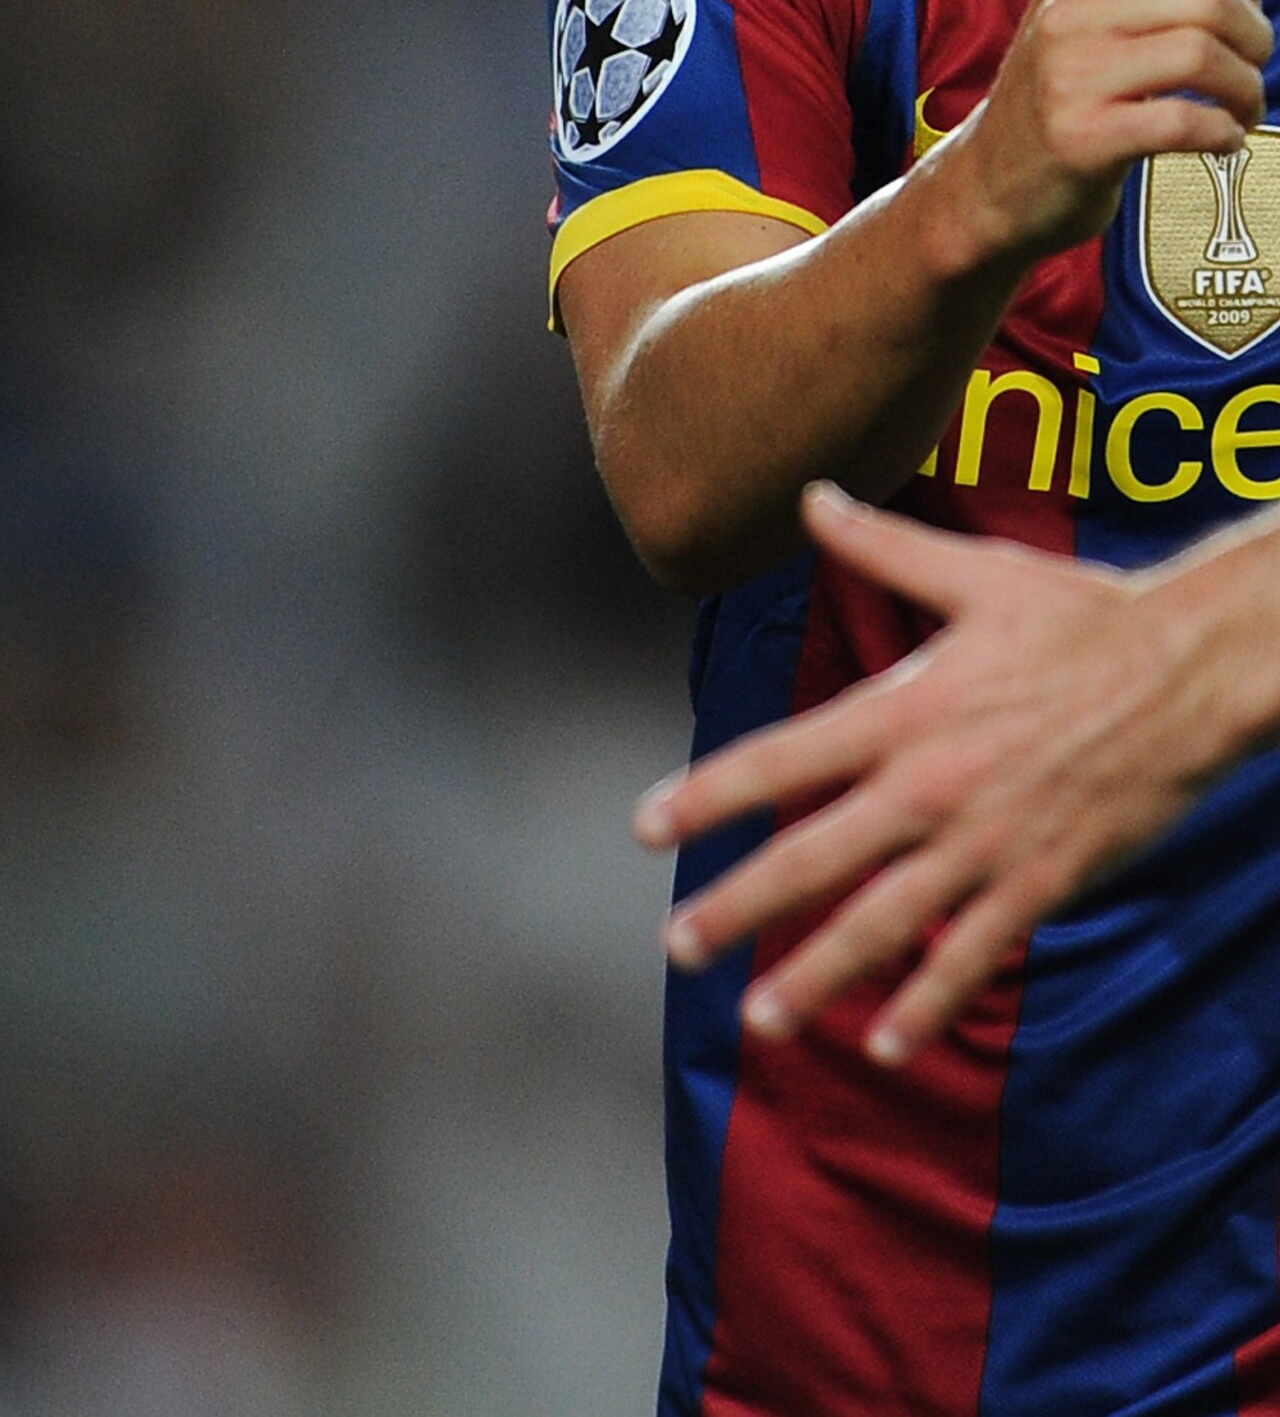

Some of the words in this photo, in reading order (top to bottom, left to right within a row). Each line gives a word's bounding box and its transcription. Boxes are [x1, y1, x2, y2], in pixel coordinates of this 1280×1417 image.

[1195, 269, 1266, 296] FIFA
[1178, 299, 1216, 308] WORLD
[1207, 309, 1251, 324] 2009
